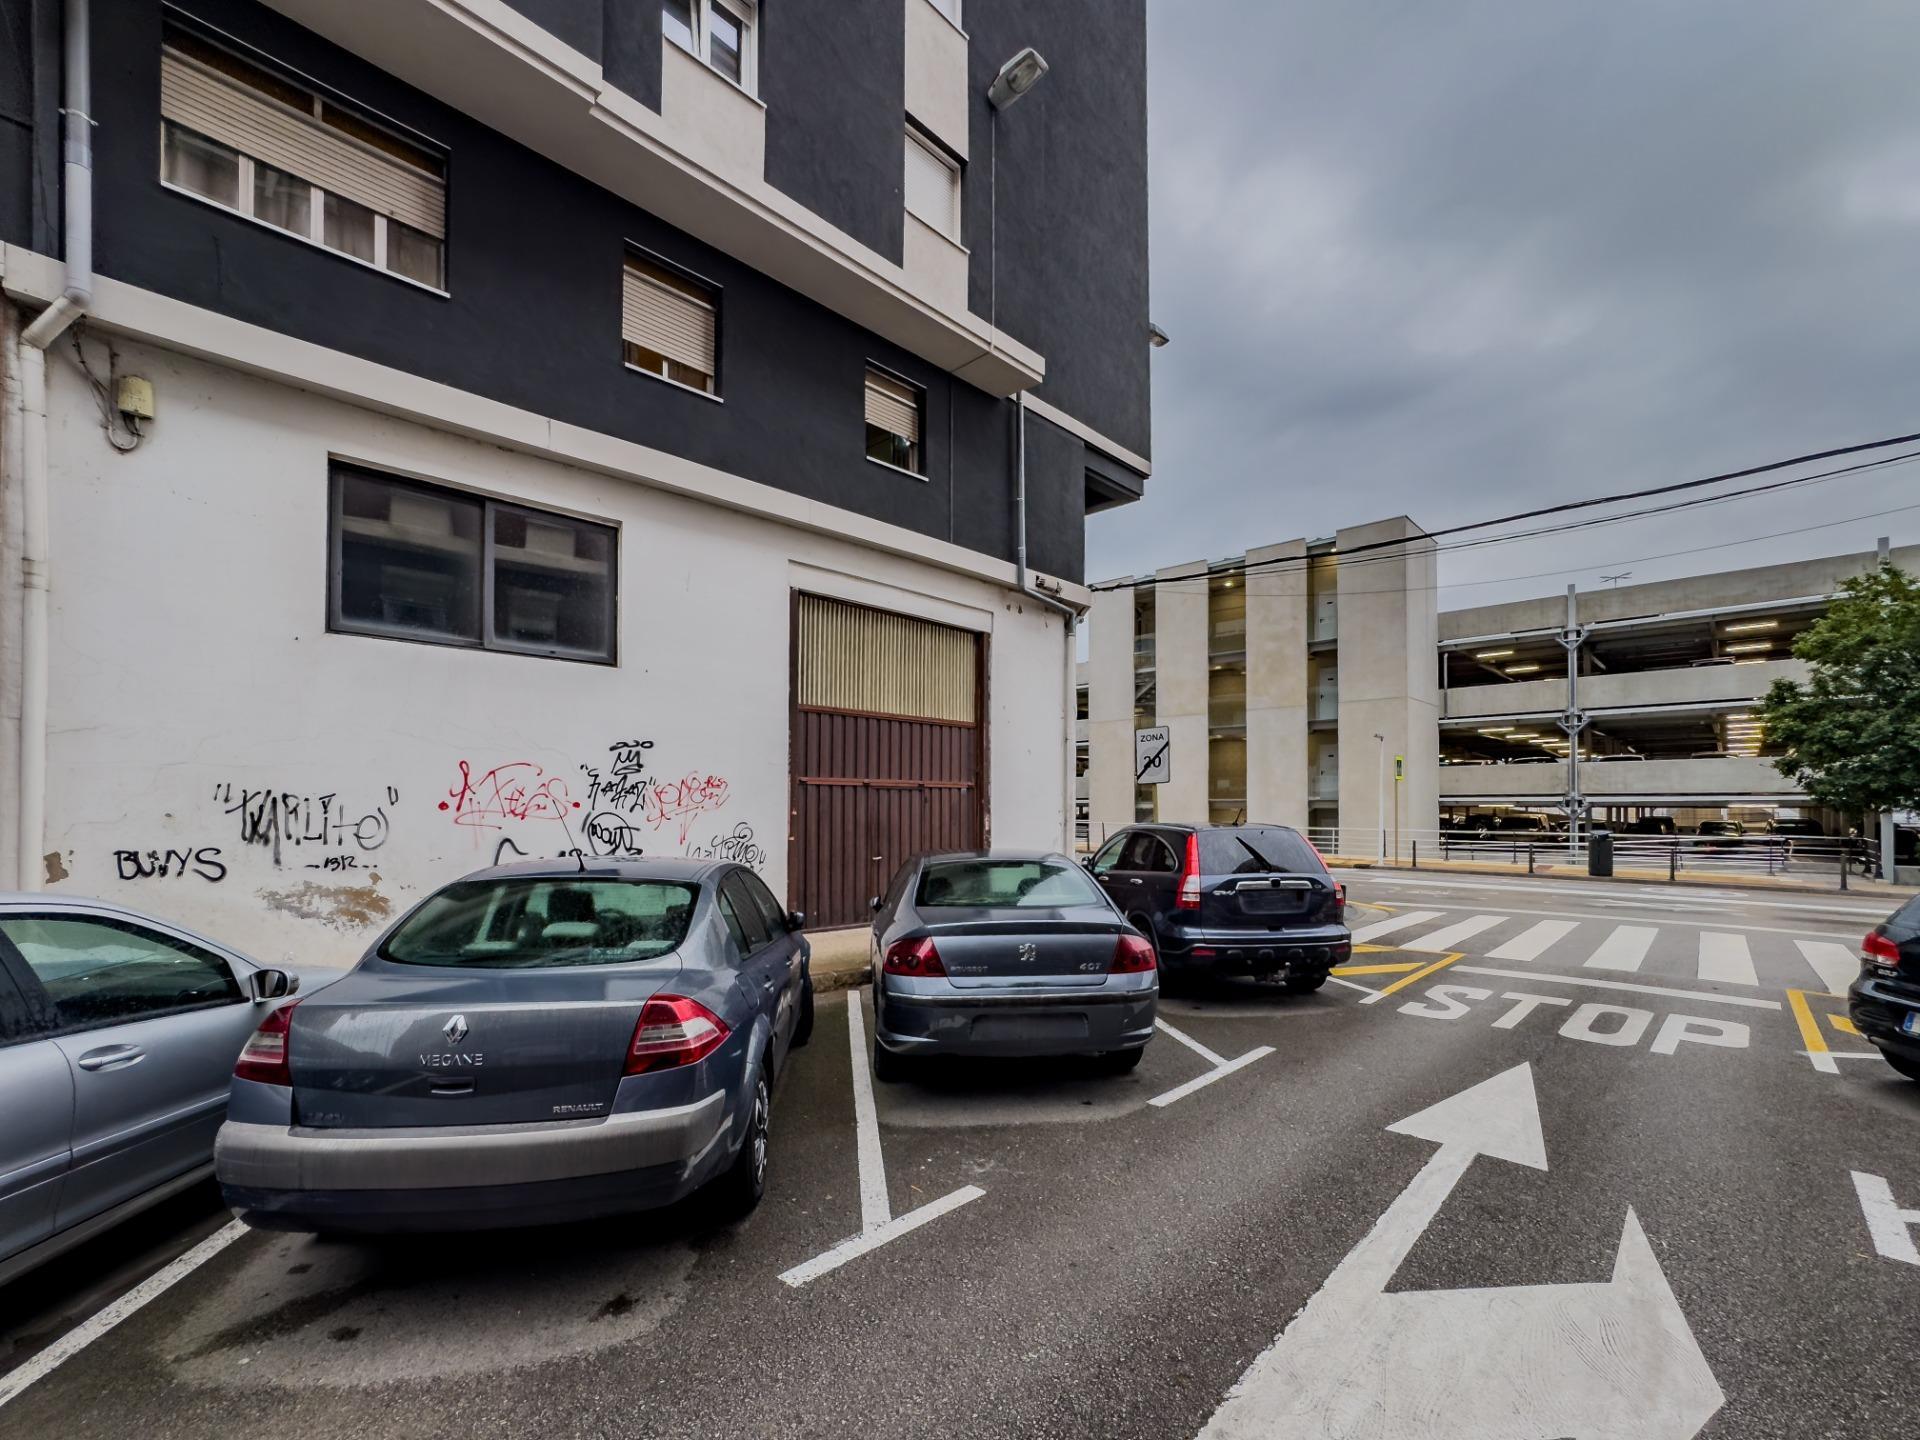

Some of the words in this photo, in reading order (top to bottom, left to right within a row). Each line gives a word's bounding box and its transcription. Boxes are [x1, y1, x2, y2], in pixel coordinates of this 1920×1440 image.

[1141, 733, 1164, 742] ZONA
[1079, 962, 1103, 971] 407
[1397, 983, 1751, 1055] STOP
[419, 1053, 484, 1067] MEGANE
[552, 1102, 604, 1114] RENAULT
